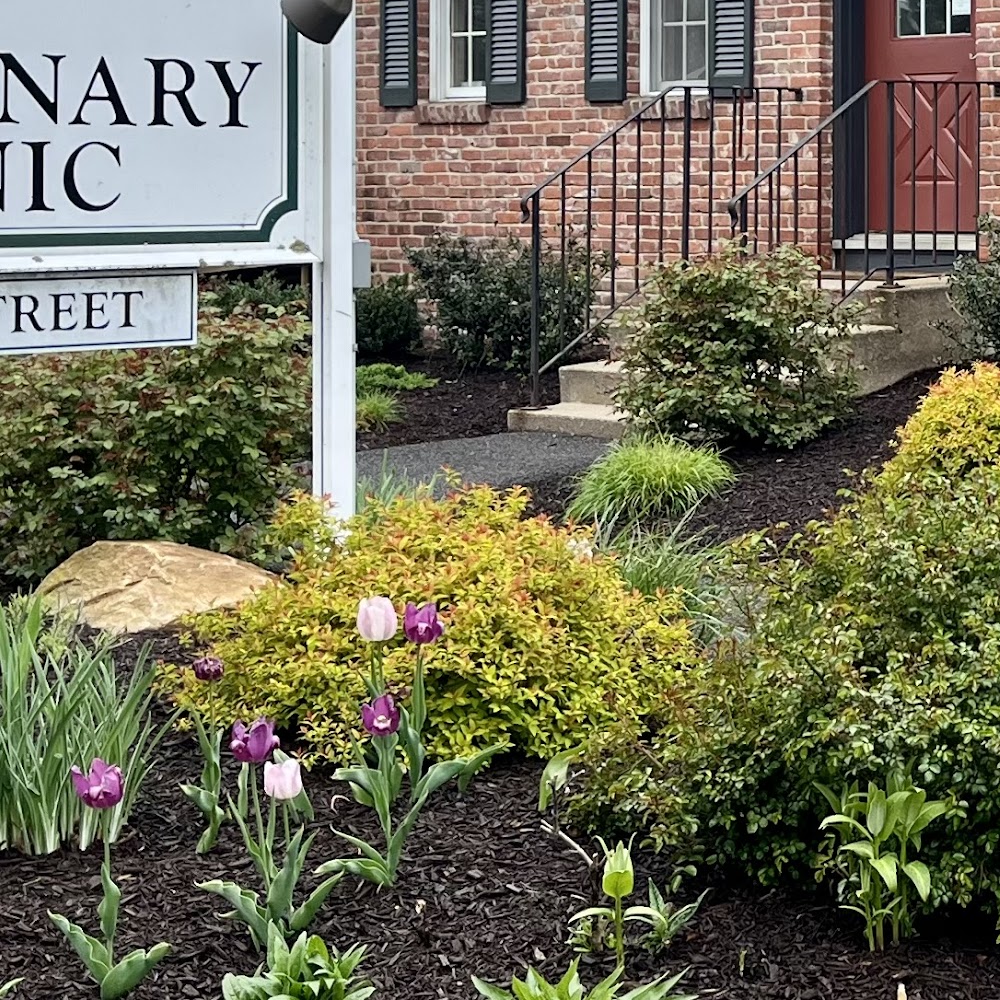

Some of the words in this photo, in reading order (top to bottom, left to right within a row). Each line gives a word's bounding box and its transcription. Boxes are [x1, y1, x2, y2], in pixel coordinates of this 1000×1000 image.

[0, 53, 262, 128] NARY
[0, 141, 121, 212] IC
[0, 290, 144, 333] REET
